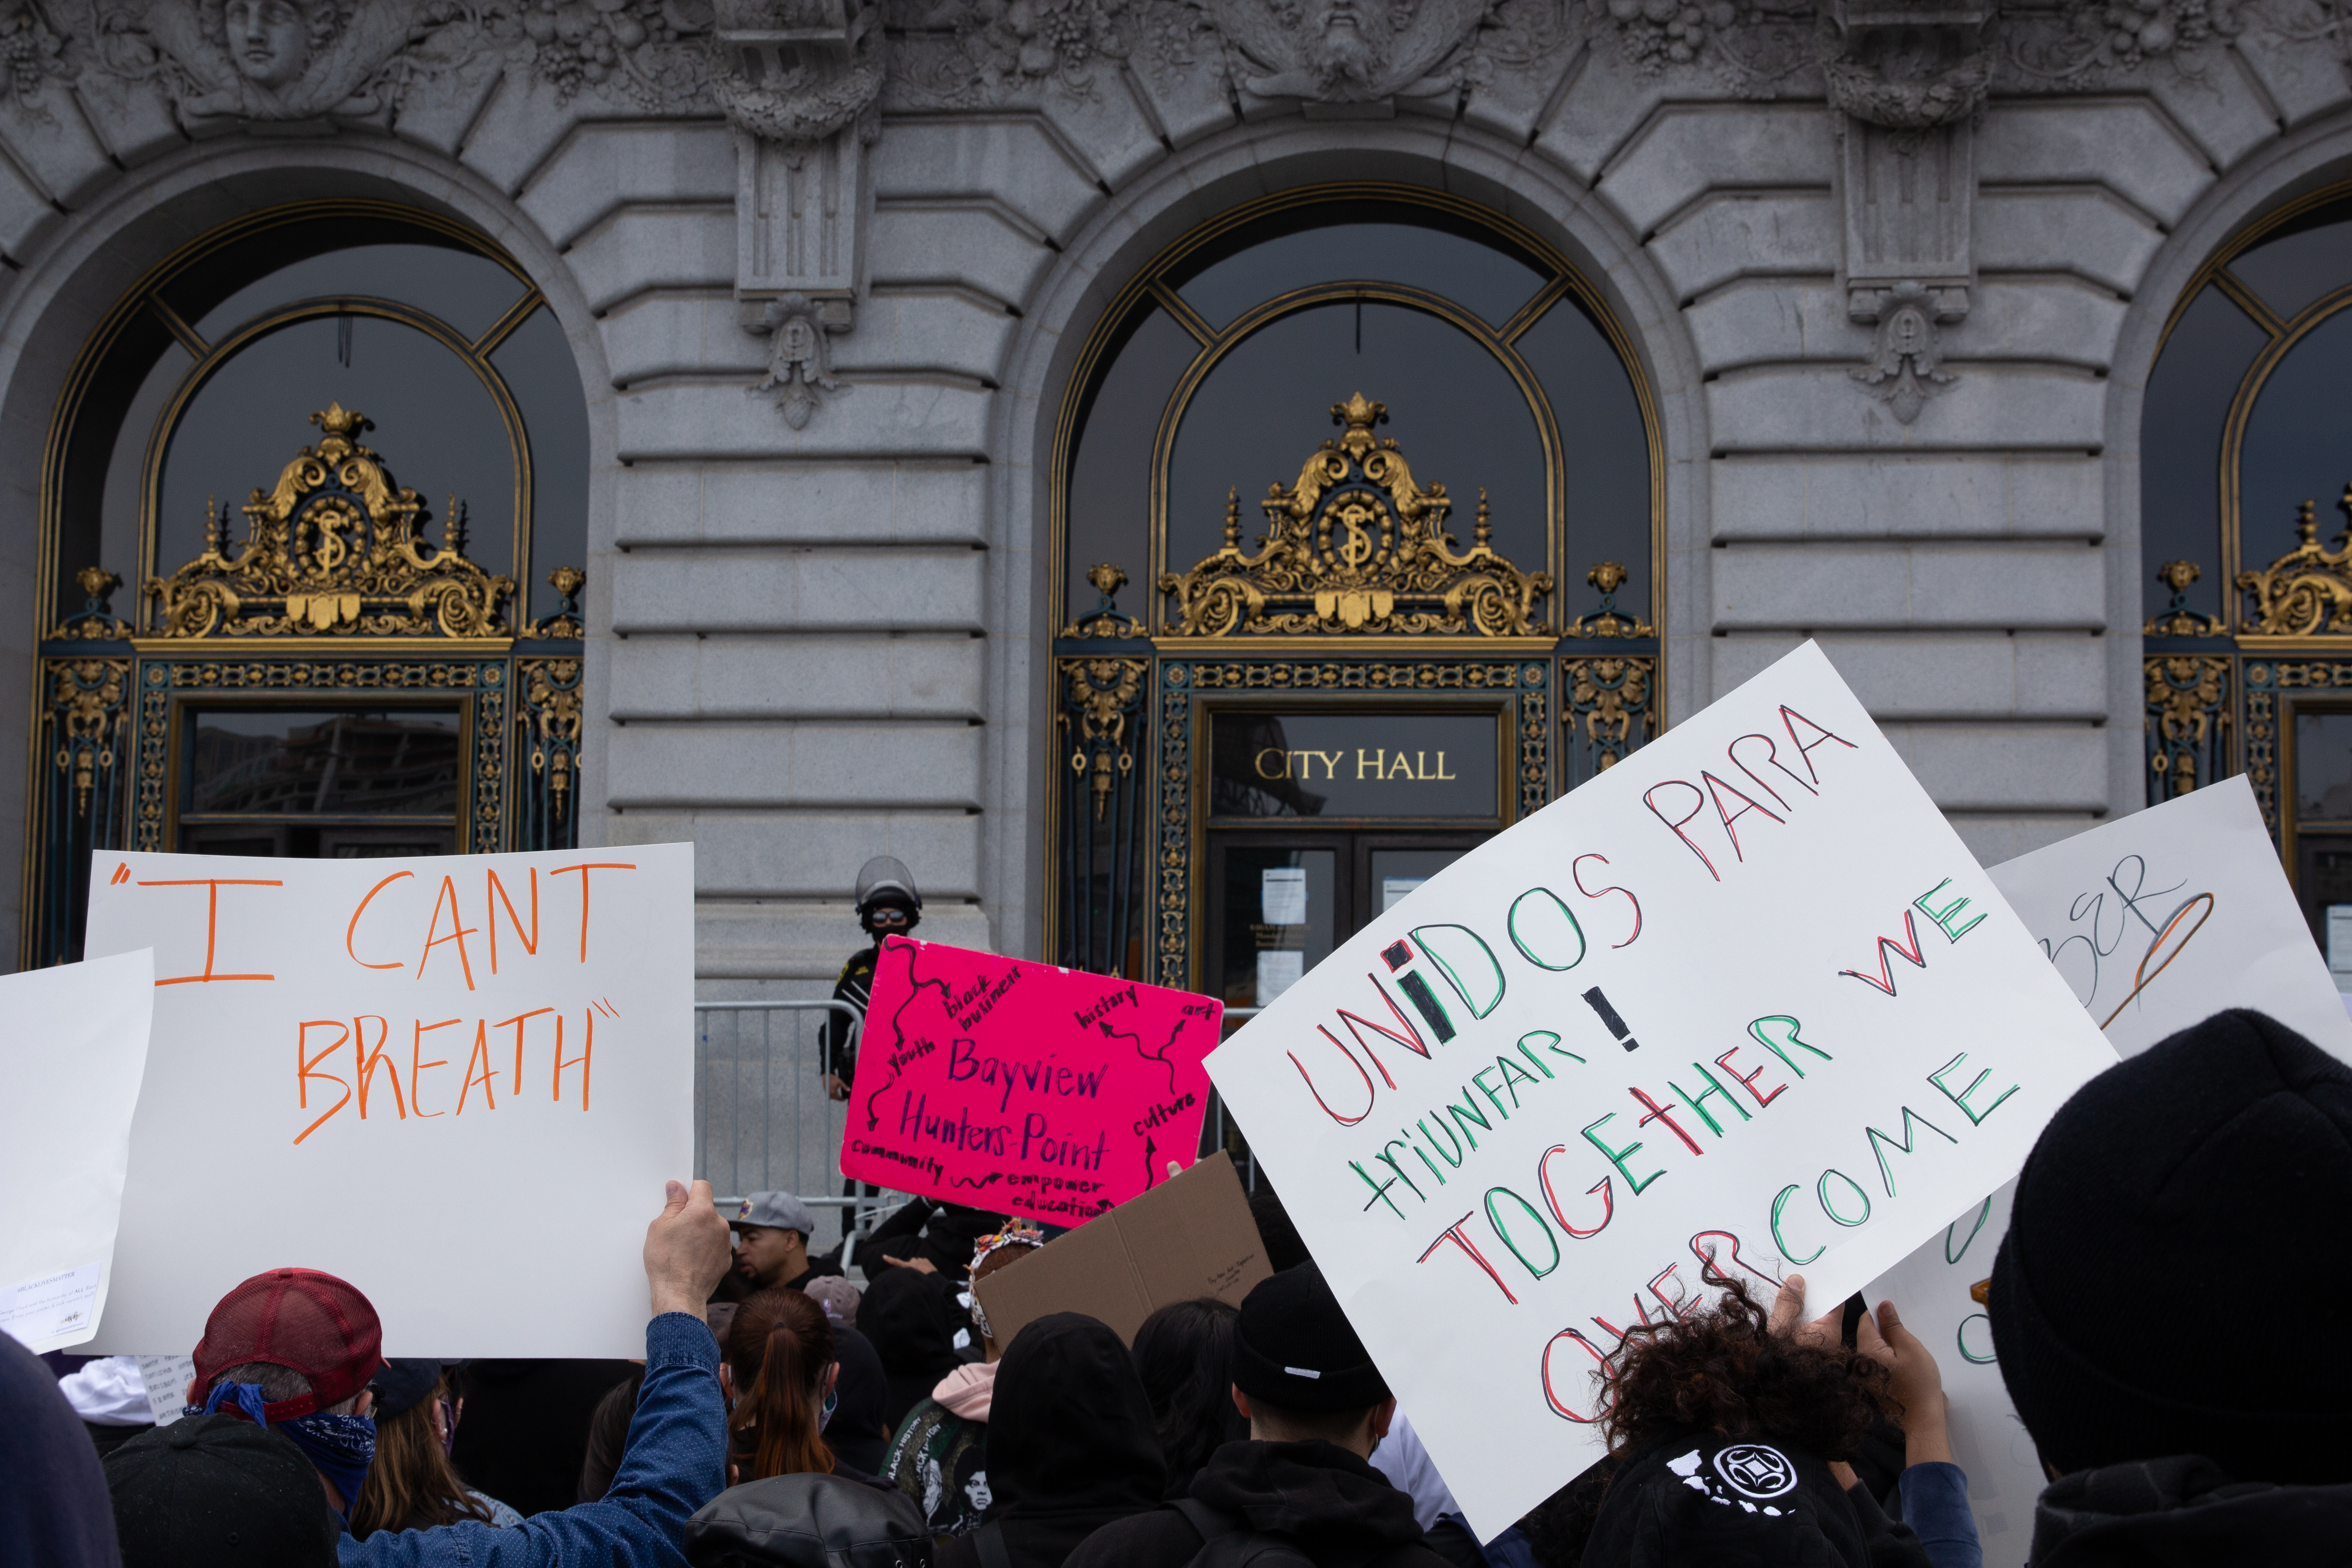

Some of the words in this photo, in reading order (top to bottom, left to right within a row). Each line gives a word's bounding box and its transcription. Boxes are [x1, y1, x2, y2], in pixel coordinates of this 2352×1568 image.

[1254, 747, 1344, 779] CITY
[1356, 748, 1456, 780] HALL
[1643, 704, 1859, 882] PARA
[346, 864, 637, 991] CANT
[1838, 877, 1989, 996] WE
[942, 974, 992, 1019] black
[957, 965, 1022, 1032] business
[1073, 985, 1139, 1029] history
[1181, 1003, 1216, 1020] art
[947, 1037, 1109, 1113] Bayview
[1770, 1052, 2020, 1265] COME
[1006, 1172, 1106, 1195] empower
[18, 1271, 75, 1293] #BLACKLIVESMATTER
[899, 1416, 922, 1448] HISTORY
